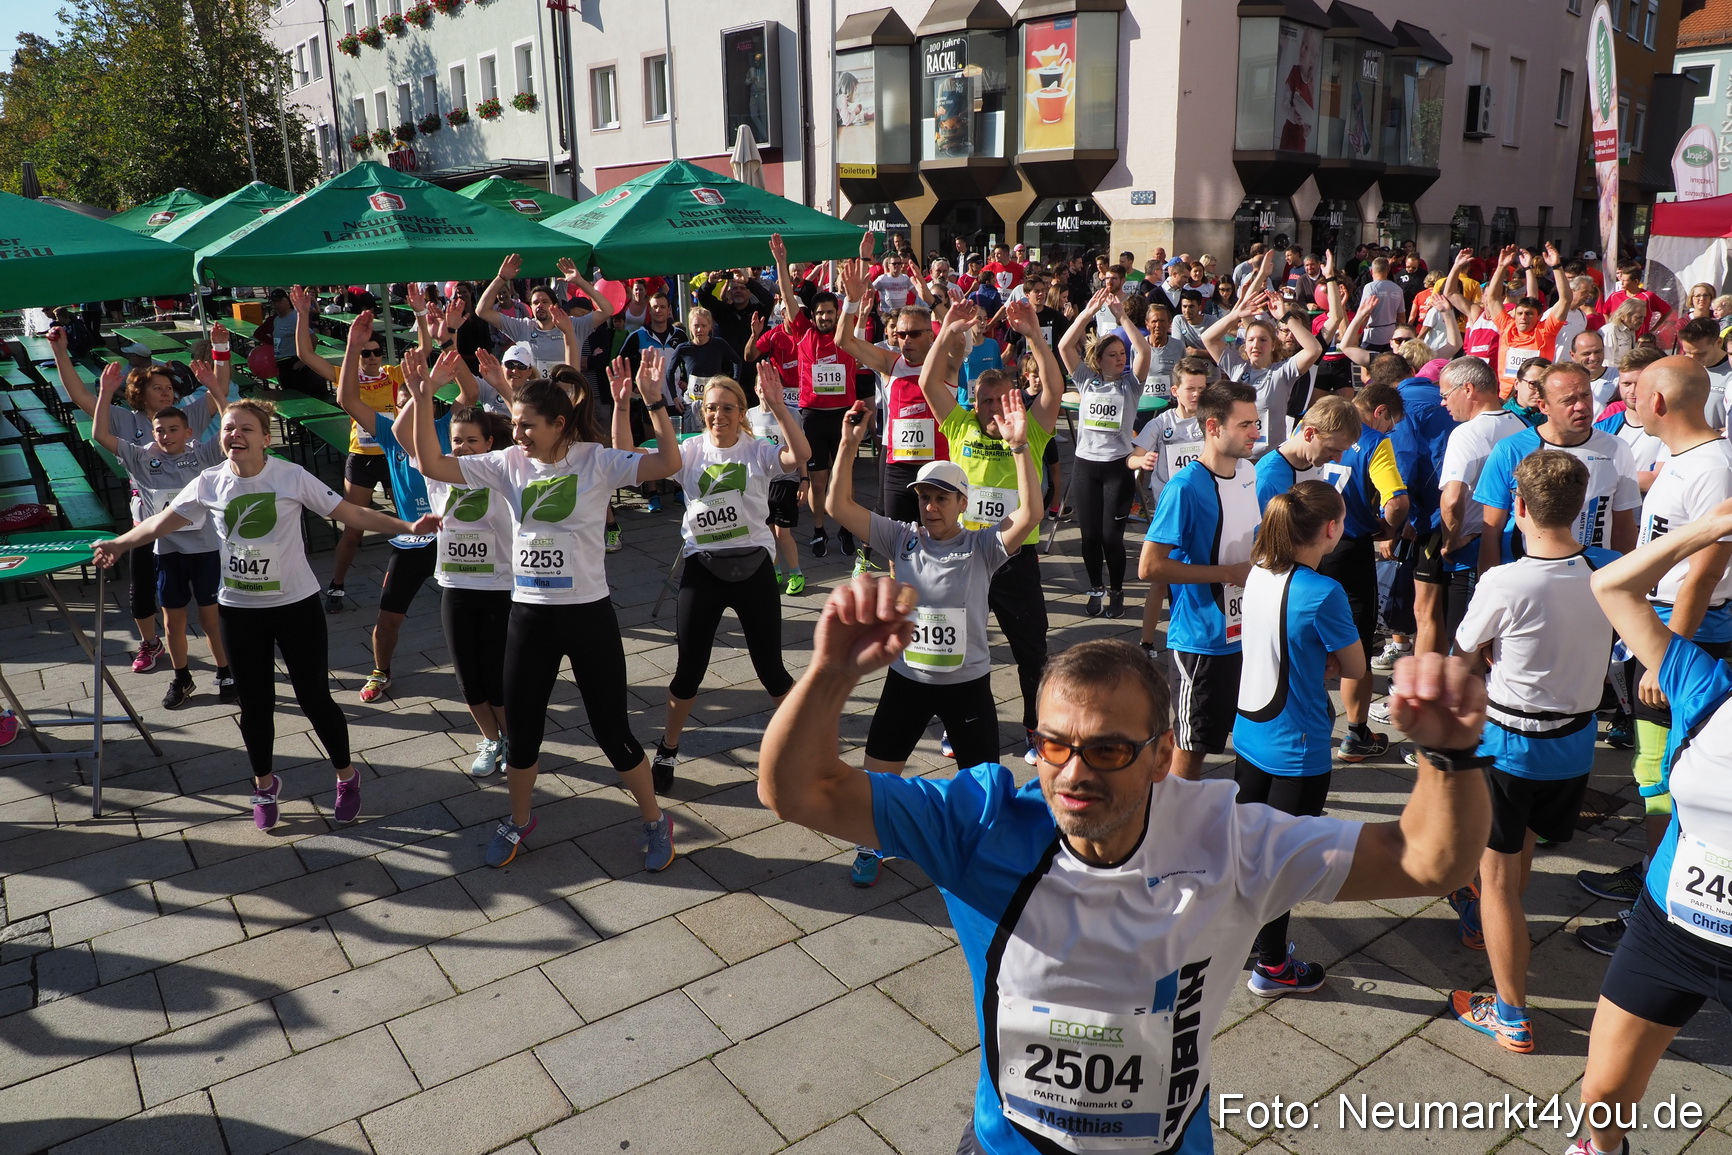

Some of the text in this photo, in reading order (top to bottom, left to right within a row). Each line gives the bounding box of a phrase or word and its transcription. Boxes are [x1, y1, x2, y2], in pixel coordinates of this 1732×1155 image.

[941, 37, 960, 50] Jahre
[840, 166, 870, 174] Toiletten
[679, 207, 763, 219] Neumarkter
[343, 214, 449, 231] Neumarkter
[666, 215, 788, 229] Lammsbräu
[1057, 216, 1079, 230] RACKL
[322, 222, 475, 243] Lammsbräu
[817, 372, 842, 382] 5118
[1145, 383, 1167, 393] 2193
[1089, 404, 1117, 417] 5008
[901, 430, 924, 443] 270
[415, 497, 428, 506] 18.
[977, 500, 1005, 518] 159
[696, 506, 738, 528] 5048
[711, 531, 733, 541] Isabel
[448, 542, 488, 558] 5049
[228, 555, 270, 575] 5047
[520, 549, 564, 569] 2253
[533, 578, 550, 587] Nina
[911, 625, 957, 646] 5193
[1690, 898, 1715, 912] PARTL
[1050, 1019, 1125, 1043] BOCK
[1163, 955, 1212, 1142] HUBER
[1024, 1043, 1144, 1094] 2504
[1033, 1089, 1118, 1109] PARTL Neumarkt
[1037, 1107, 1123, 1134] Matthias
